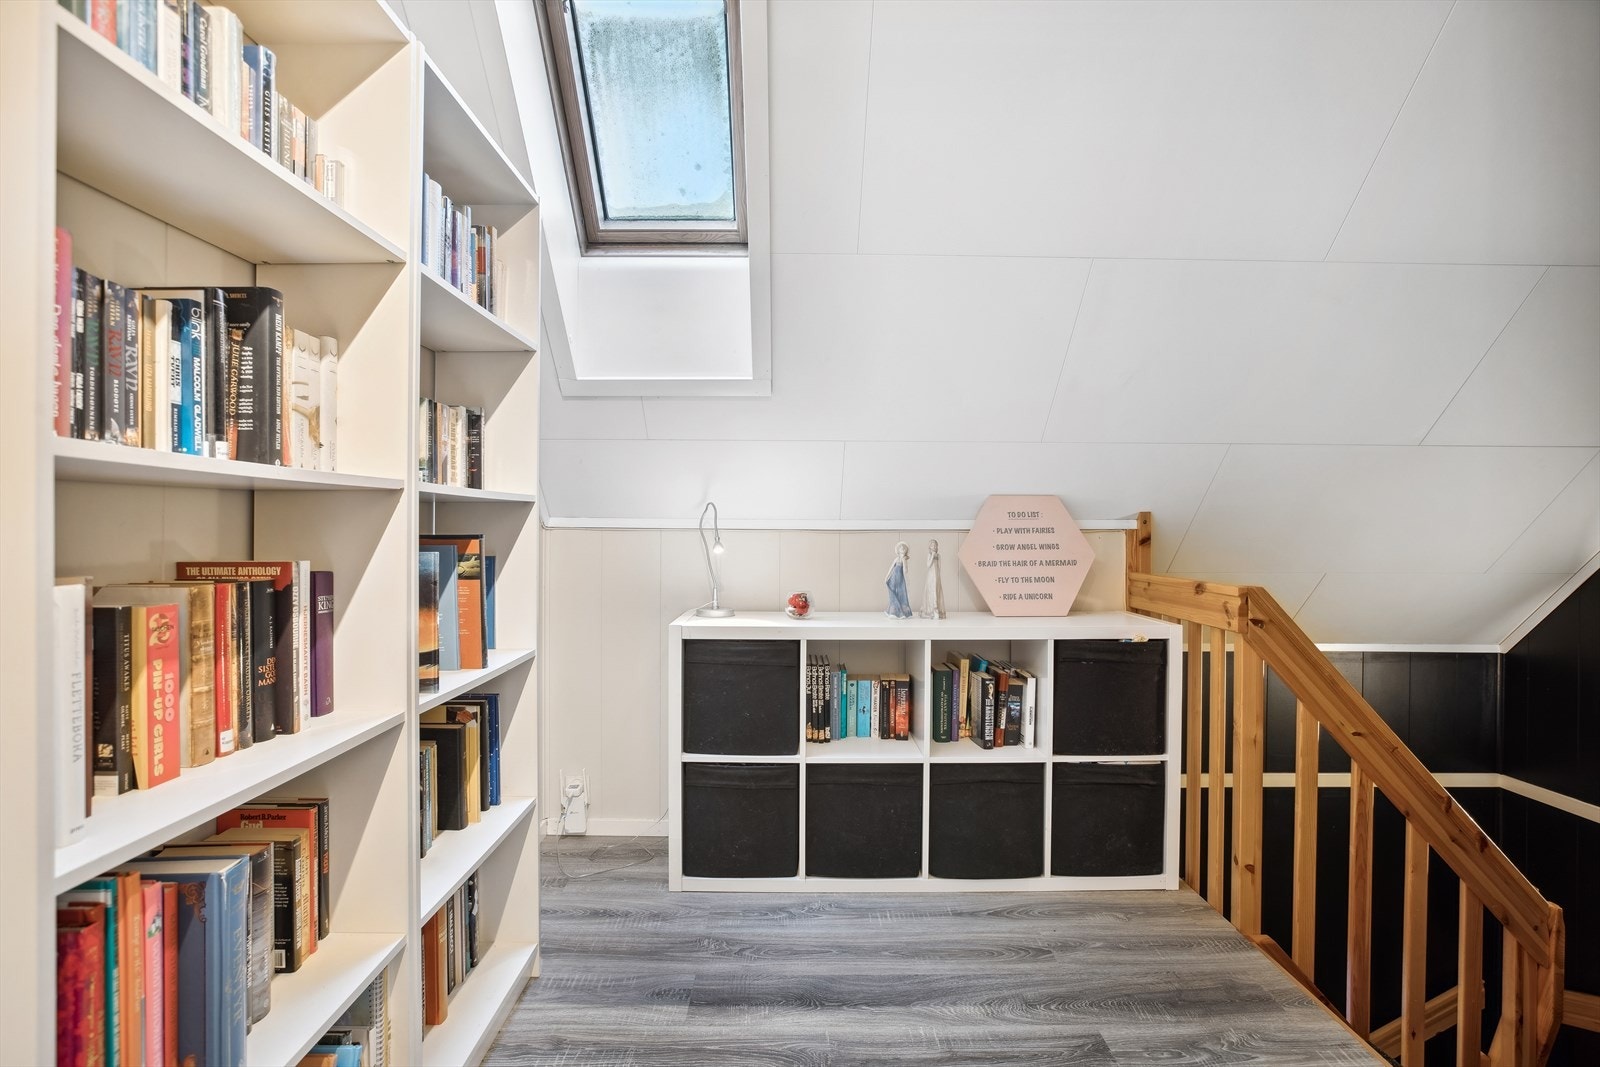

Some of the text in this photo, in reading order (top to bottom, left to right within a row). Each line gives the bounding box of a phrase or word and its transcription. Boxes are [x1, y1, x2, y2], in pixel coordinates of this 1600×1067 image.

[199, 17, 208, 90] Carol Goodman
[263, 90, 271, 157] GILES KRISTI
[191, 307, 202, 340] blink
[230, 341, 240, 367] JULIE
[193, 357, 202, 451] MALCOLM GLADWELL
[228, 368, 239, 416] GARWOOD
[186, 566, 281, 576] THE ULTIMATE ANTHOLOGY
[152, 658, 165, 777] PIN-UP GIRLS
[164, 672, 175, 722] 1000
[985, 706, 994, 741] KRISTENSEN
[240, 813, 261, 821] Robert
